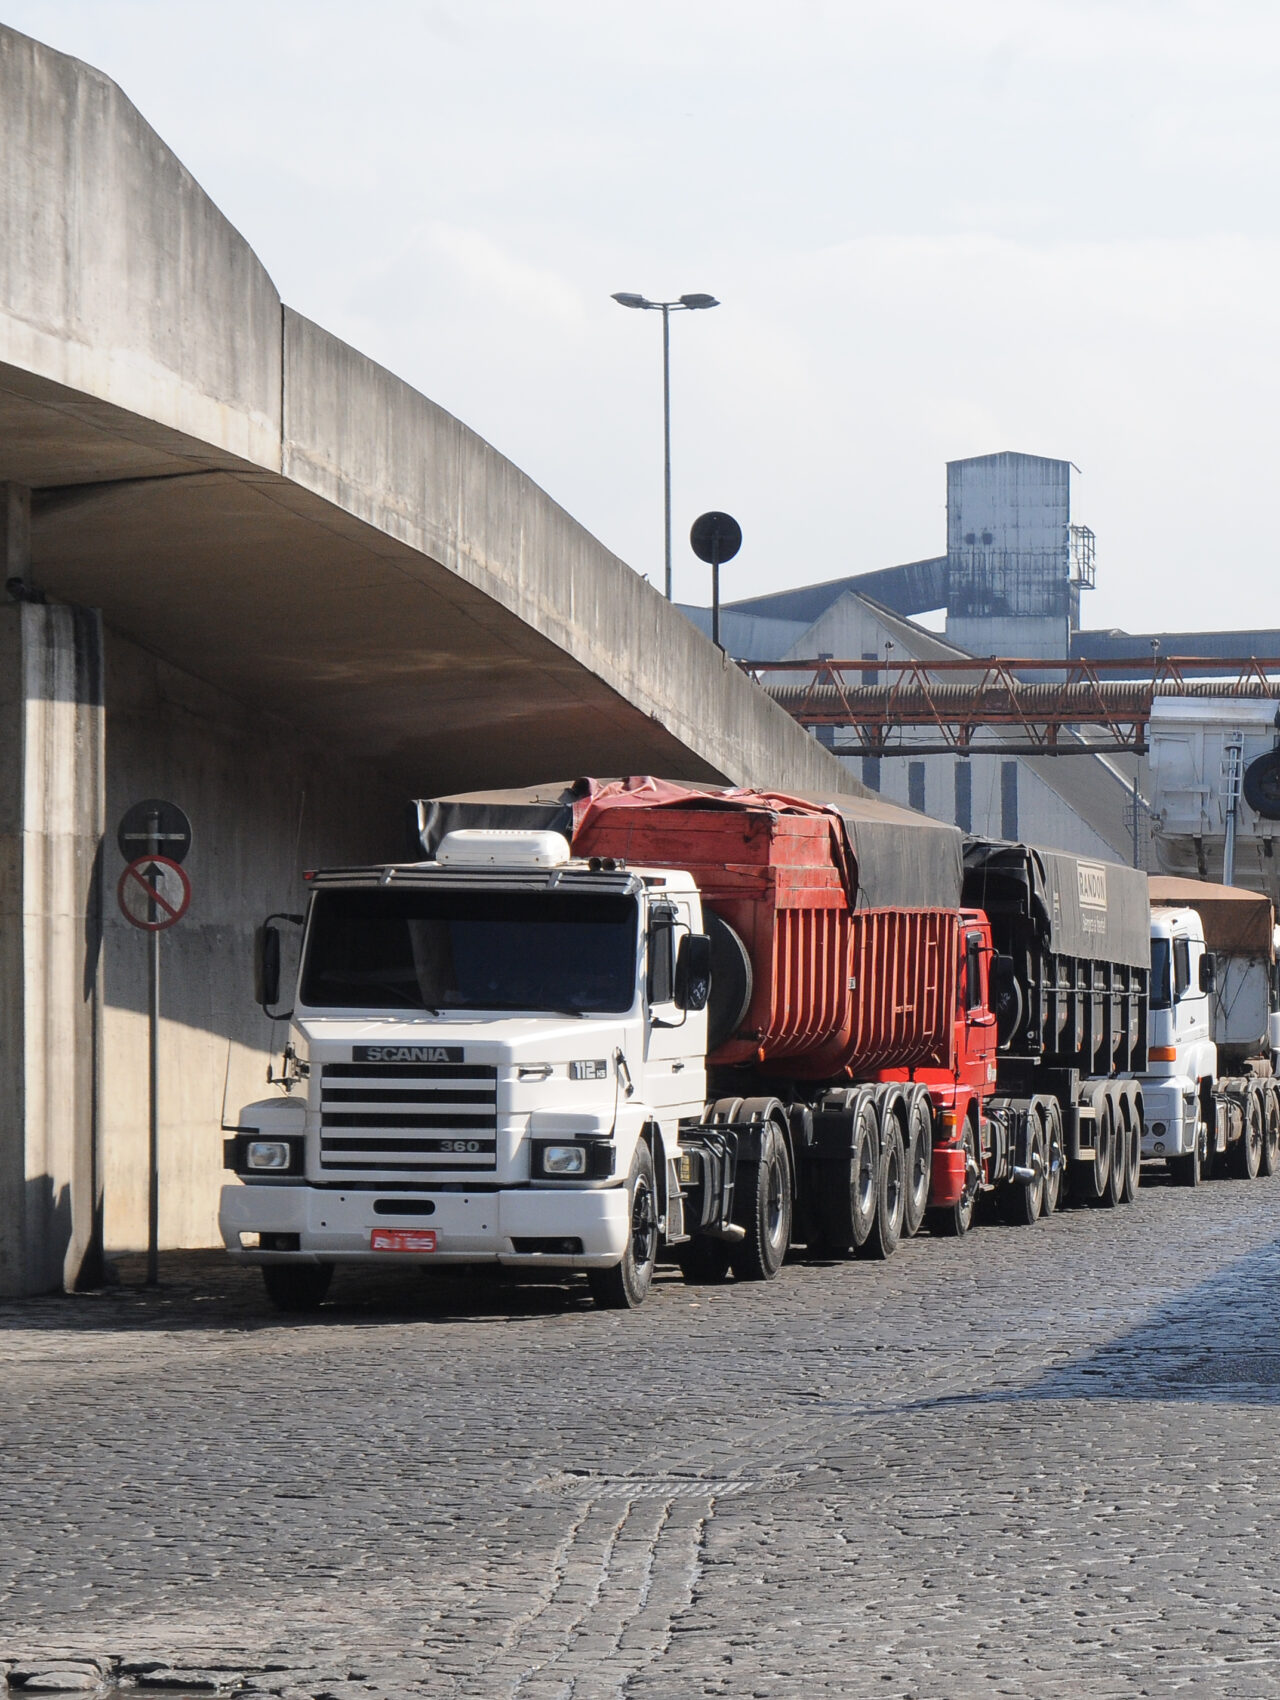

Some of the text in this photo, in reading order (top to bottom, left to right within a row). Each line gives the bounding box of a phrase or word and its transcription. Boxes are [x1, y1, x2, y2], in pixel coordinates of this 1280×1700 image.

[1078, 871, 1106, 900] RANDON
[366, 1047, 450, 1062] SCANIA
[574, 1061, 596, 1079] 112
[440, 1140, 480, 1152] 360
